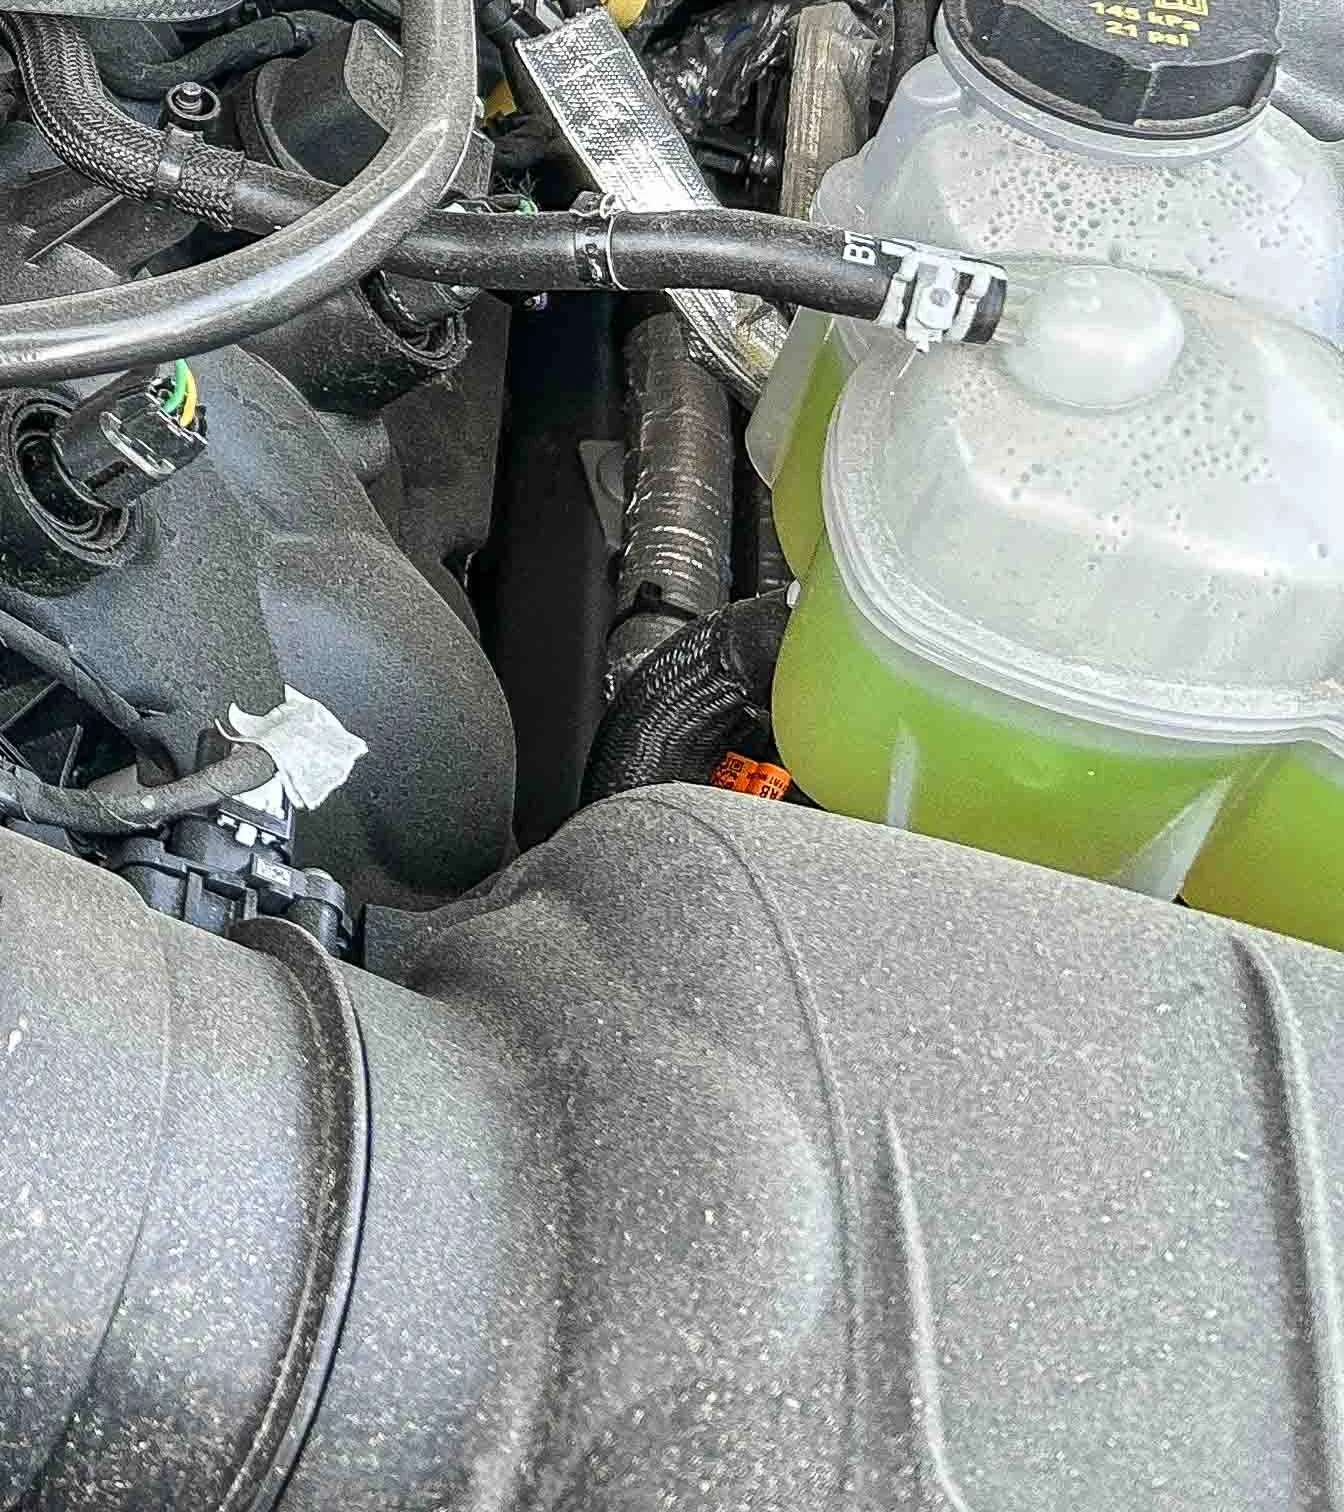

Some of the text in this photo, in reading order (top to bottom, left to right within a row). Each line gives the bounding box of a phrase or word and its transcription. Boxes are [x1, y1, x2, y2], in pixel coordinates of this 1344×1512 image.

[1147, 11, 1201, 32] kPa
[1104, 20, 1190, 48] 21 psi
